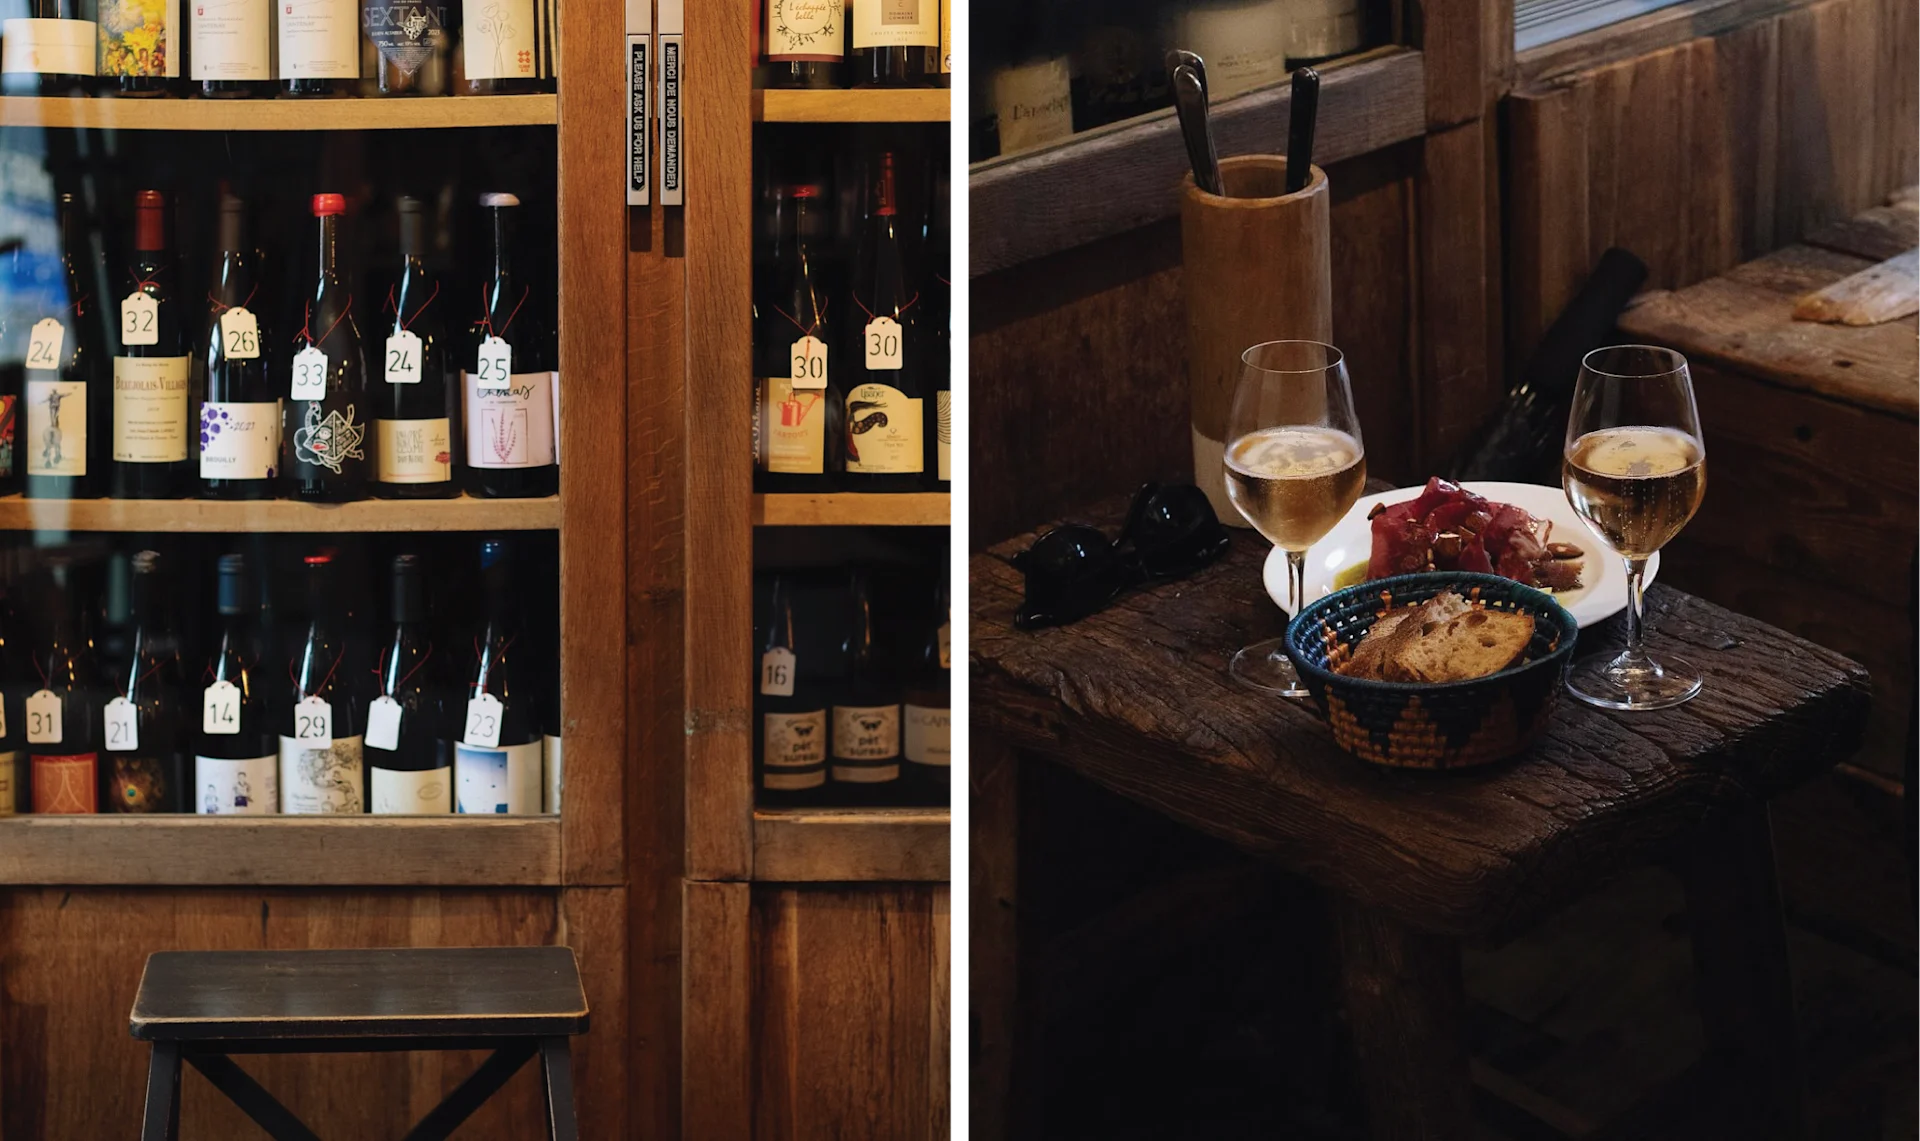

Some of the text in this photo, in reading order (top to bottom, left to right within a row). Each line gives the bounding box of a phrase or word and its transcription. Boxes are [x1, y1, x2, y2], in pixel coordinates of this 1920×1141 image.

[363, 6, 448, 27] SEXTANT
[795, 11, 815, 20] belle
[633, 50, 644, 184] PLEASE ASK US FOR HELP
[666, 46, 677, 188] MERCI DE NOUS DEMANDER
[126, 310, 154, 333] 32
[30, 341, 54, 363] 24
[228, 331, 255, 353] 26
[869, 333, 898, 356] 30
[388, 350, 414, 373] 24
[478, 358, 507, 381] 25
[794, 355, 823, 378] 30
[297, 363, 324, 387] 33
[766, 664, 787, 686] 16
[30, 712, 52, 735] 31
[210, 703, 234, 724] 14
[469, 713, 496, 737] 23
[110, 721, 129, 743] 21
[299, 716, 326, 739] 29
